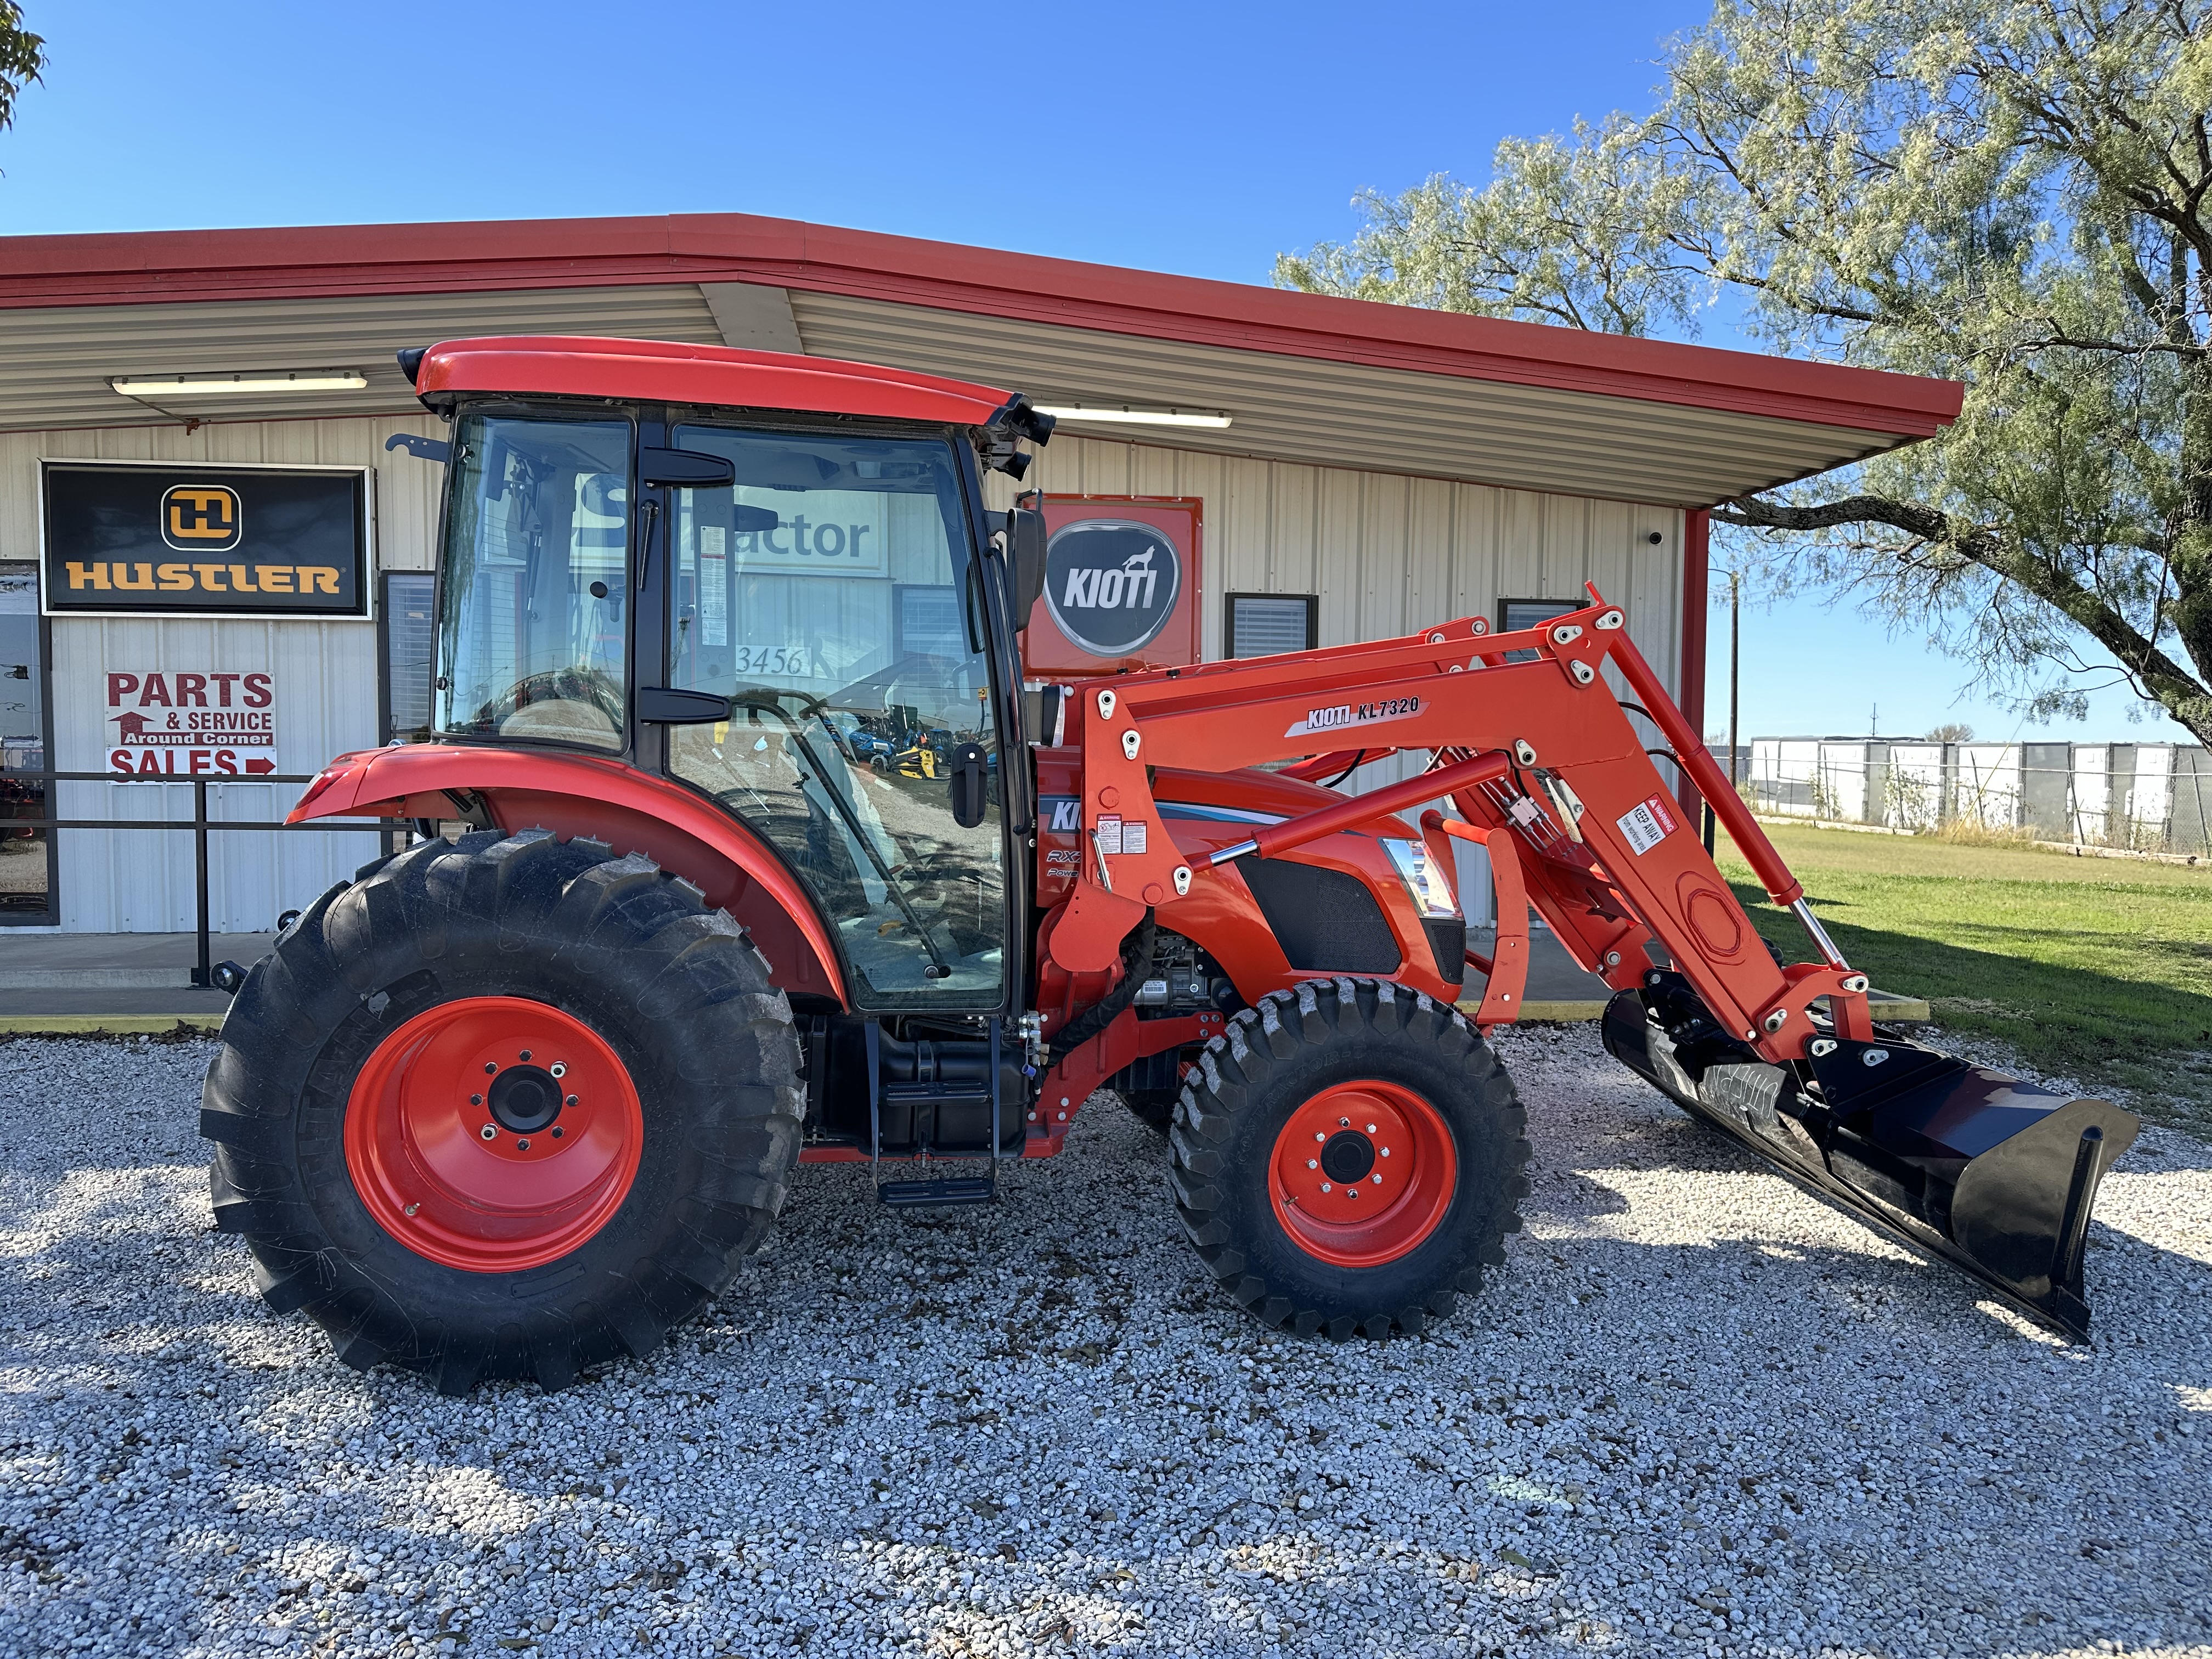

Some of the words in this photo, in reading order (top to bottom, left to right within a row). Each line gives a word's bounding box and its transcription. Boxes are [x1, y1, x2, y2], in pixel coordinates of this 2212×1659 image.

[65, 561, 340, 594] HUSTLER
[1063, 568, 1158, 609] KIOTI
[736, 647, 805, 675] 3456
[108, 673, 273, 708] PARTS
[166, 712, 180, 730] &
[188, 712, 273, 730] SERVICE
[1306, 703, 1351, 730] KIOTI
[1357, 695, 1421, 722] KL7320
[124, 732, 195, 744] Around
[202, 732, 270, 744] Corner
[110, 749, 238, 783] SALES
[1052, 802, 1081, 830] KI
[1632, 806, 1650, 825] KEEP
[1642, 822, 1662, 843] AWAY
[1654, 804, 1675, 833] WARNING
[1627, 826, 1641, 844] working
[1047, 868, 1079, 878] Powe
